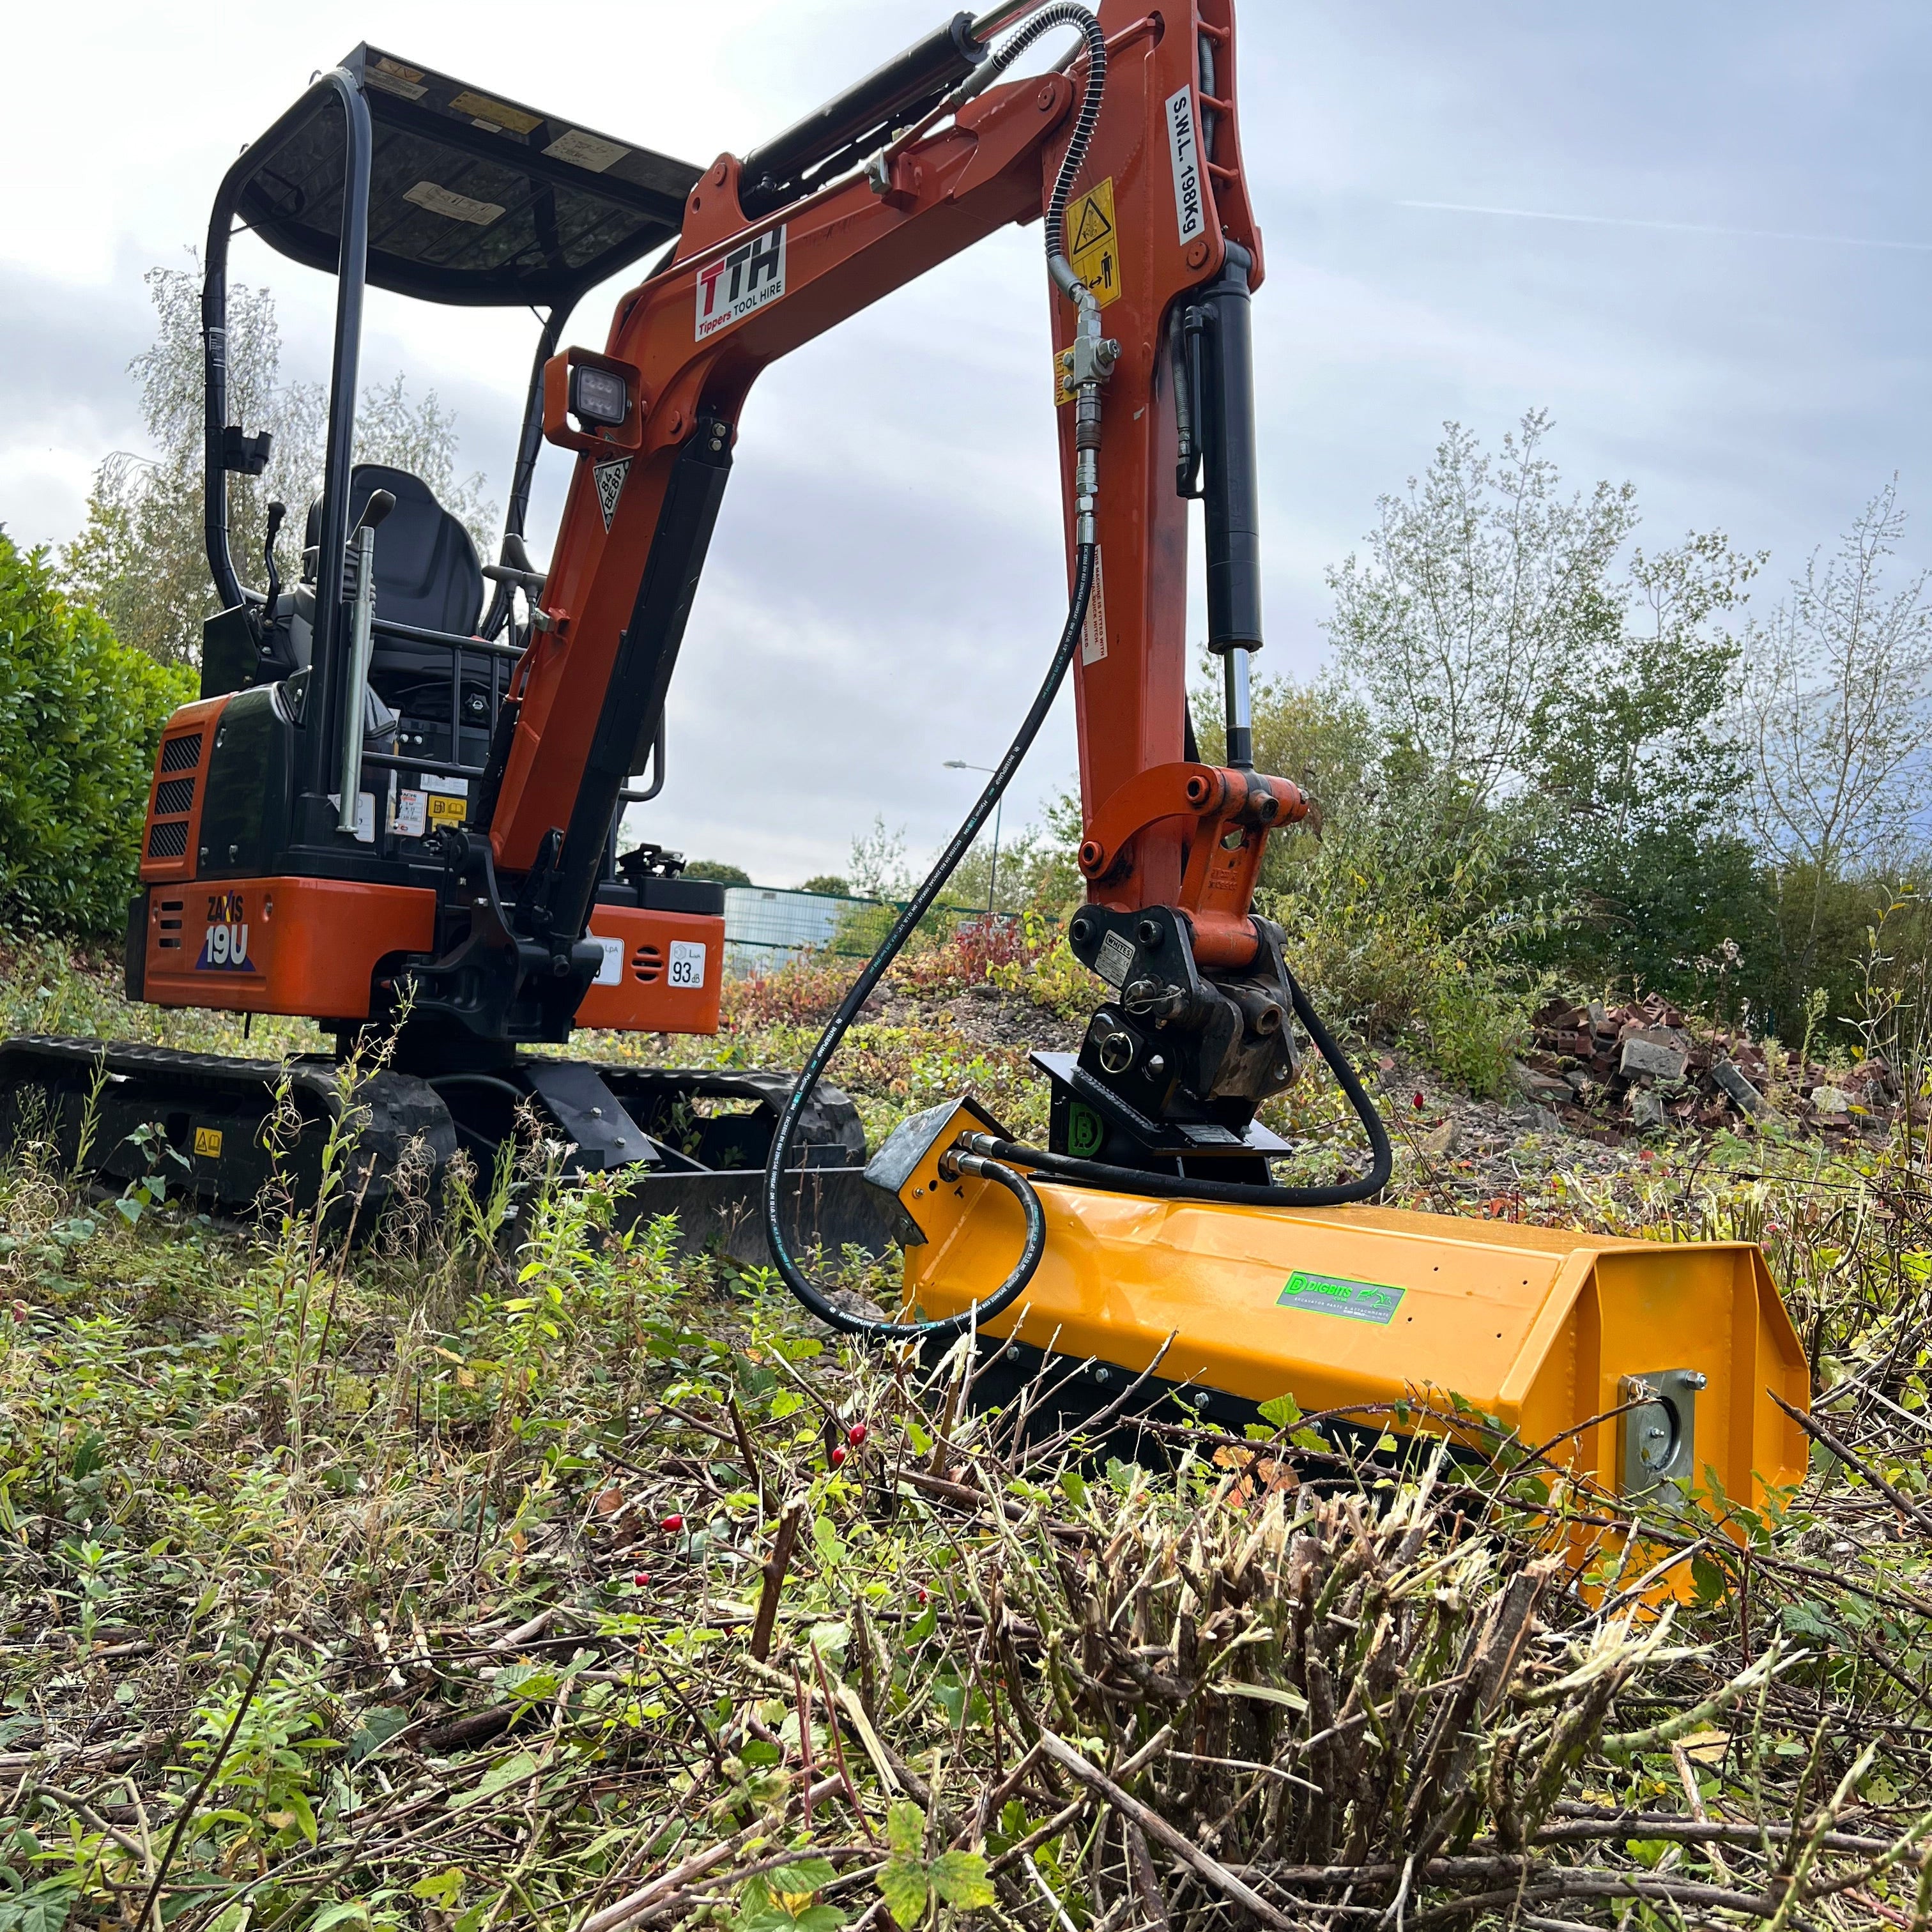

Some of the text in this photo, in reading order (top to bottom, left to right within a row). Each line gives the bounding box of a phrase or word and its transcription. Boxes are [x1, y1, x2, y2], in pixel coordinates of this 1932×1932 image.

[1174, 96, 1199, 234] S.W.L. 198Kg
[700, 225, 782, 318] TTH
[699, 280, 781, 335] Tippers TOOL HIRE
[1056, 353, 1064, 402] RETURN
[995, 754, 1015, 785] INTERPUMP
[207, 889, 243, 923] ZAXIS
[206, 924, 249, 965] 19U
[1108, 936, 1131, 956] WHITES
[673, 961, 700, 983] 93 dB
[816, 1026, 837, 1058] INTERPUMP
[1306, 1280, 1353, 1298] DIGBITS
[839, 1311, 877, 1327] INTERPUMP
[1294, 1297, 1325, 1306] EXCAVATOR
[1349, 1307, 1389, 1317] ATTACHMENTS
